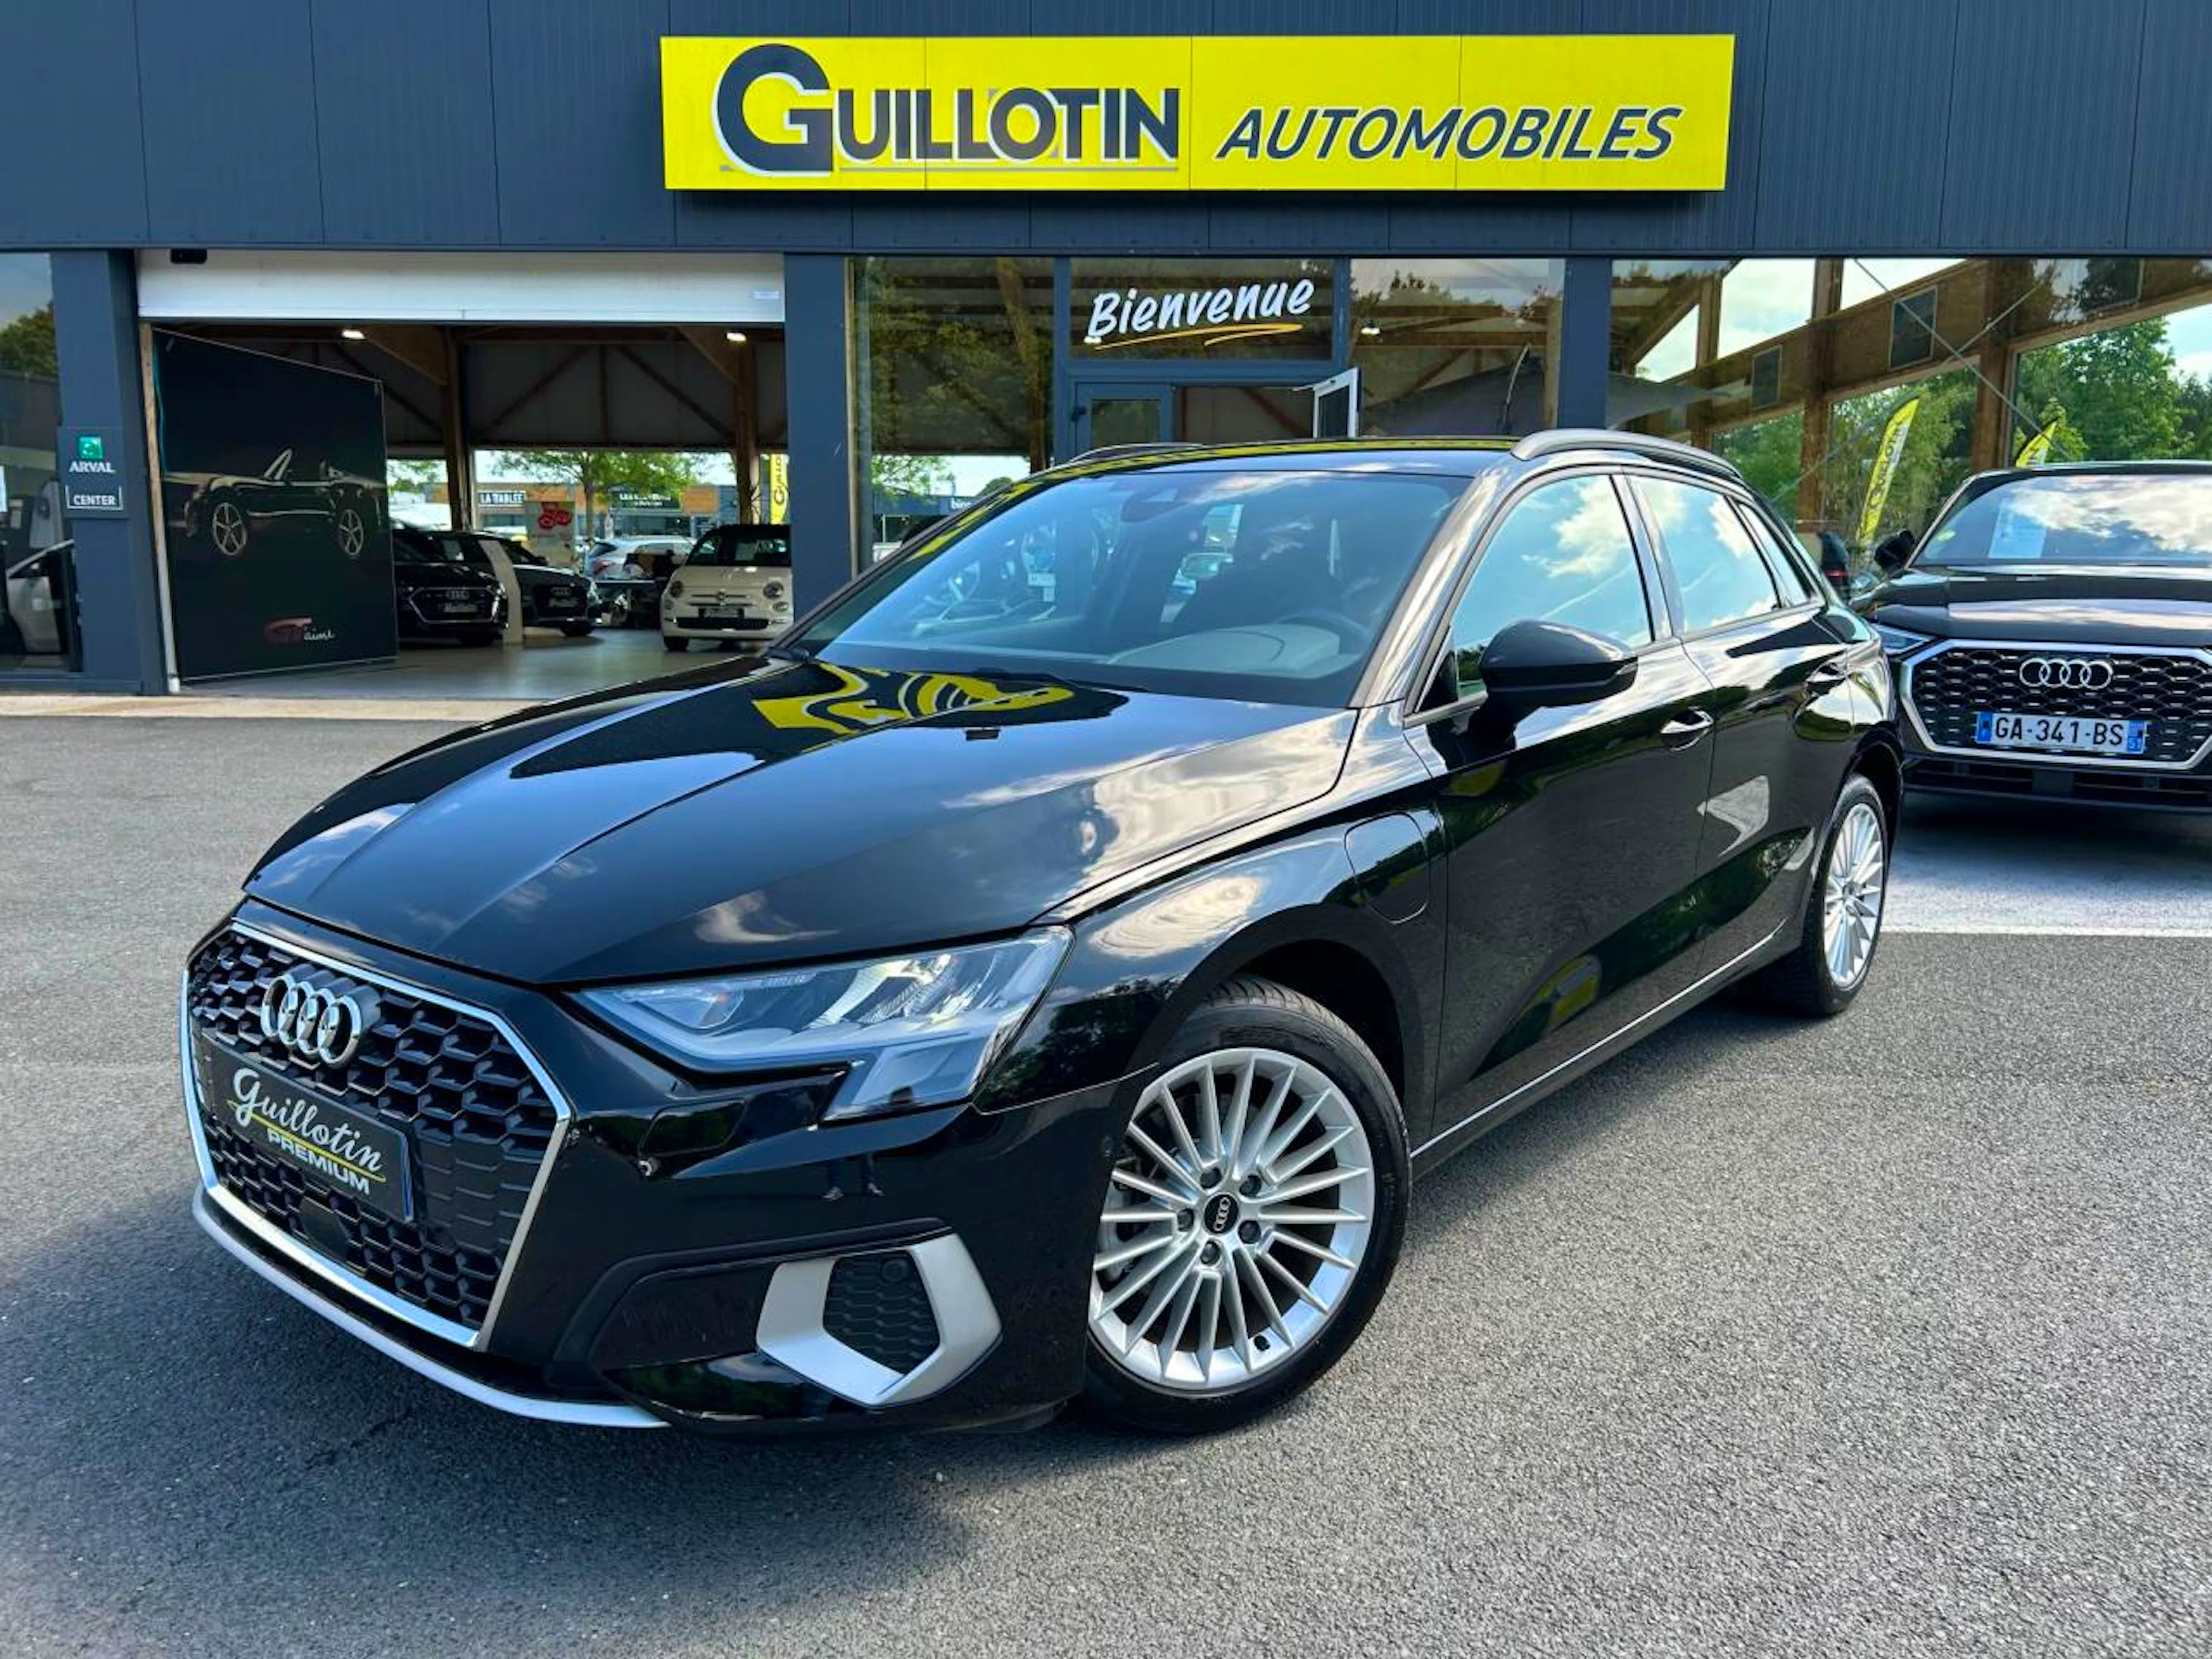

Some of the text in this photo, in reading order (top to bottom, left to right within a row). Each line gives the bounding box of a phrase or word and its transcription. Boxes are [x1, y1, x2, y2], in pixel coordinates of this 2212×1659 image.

[714, 42, 1685, 176] GUILLOTIN AUTOMOBILES
[1084, 279, 1315, 344] Bienvenue
[69, 461, 116, 473] ARVAL
[73, 495, 116, 505] CENTER
[1995, 717, 2124, 745] GA-341-BS
[233, 1067, 384, 1172] Guillotin
[267, 1127, 370, 1195] PREMIUM
